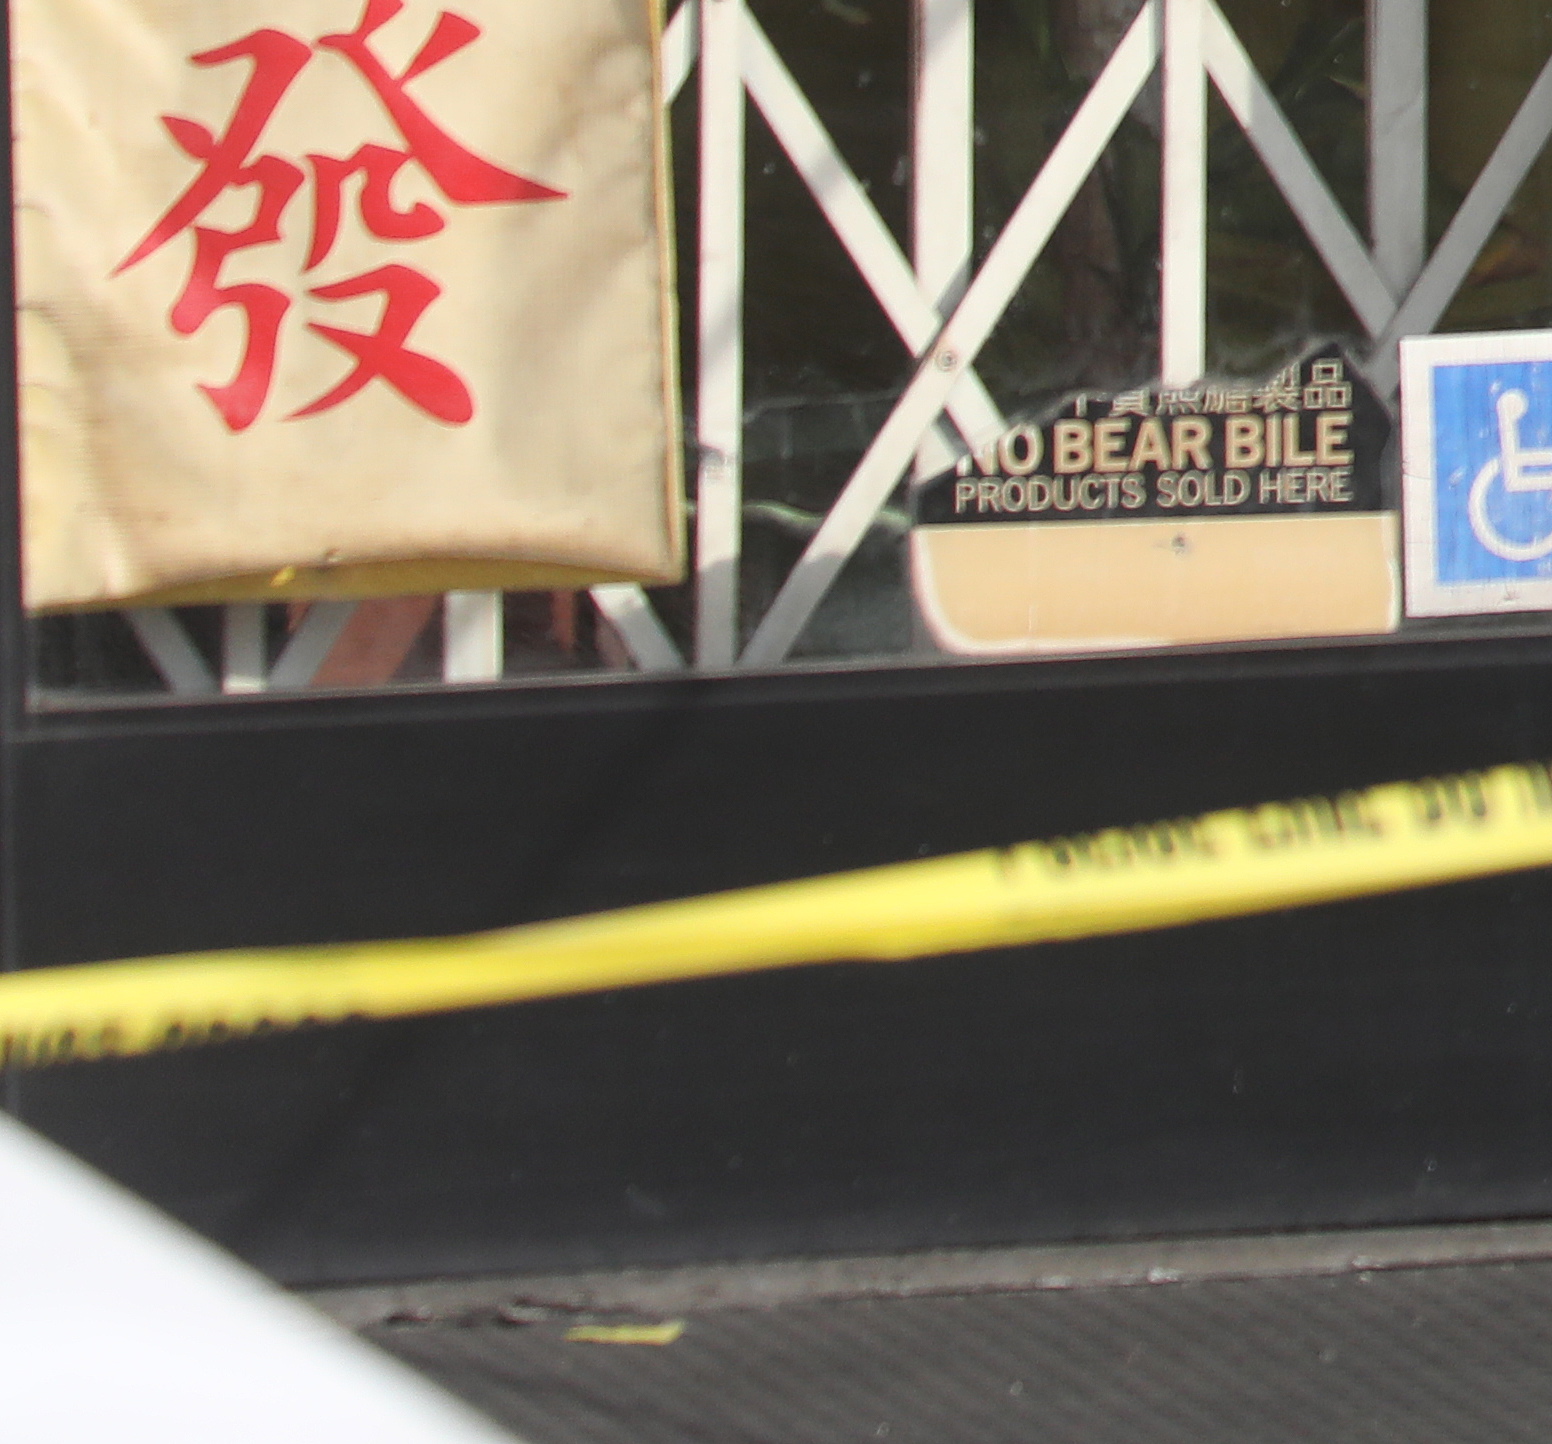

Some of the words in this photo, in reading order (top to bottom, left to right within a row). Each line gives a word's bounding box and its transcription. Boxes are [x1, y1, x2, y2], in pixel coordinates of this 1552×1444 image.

[1053, 416, 1214, 474] BEAR
[1224, 410, 1355, 470] BILE
[955, 472, 1148, 515] PRODUCTS
[1155, 468, 1250, 508] SOLD
[1258, 466, 1355, 505] HERE
